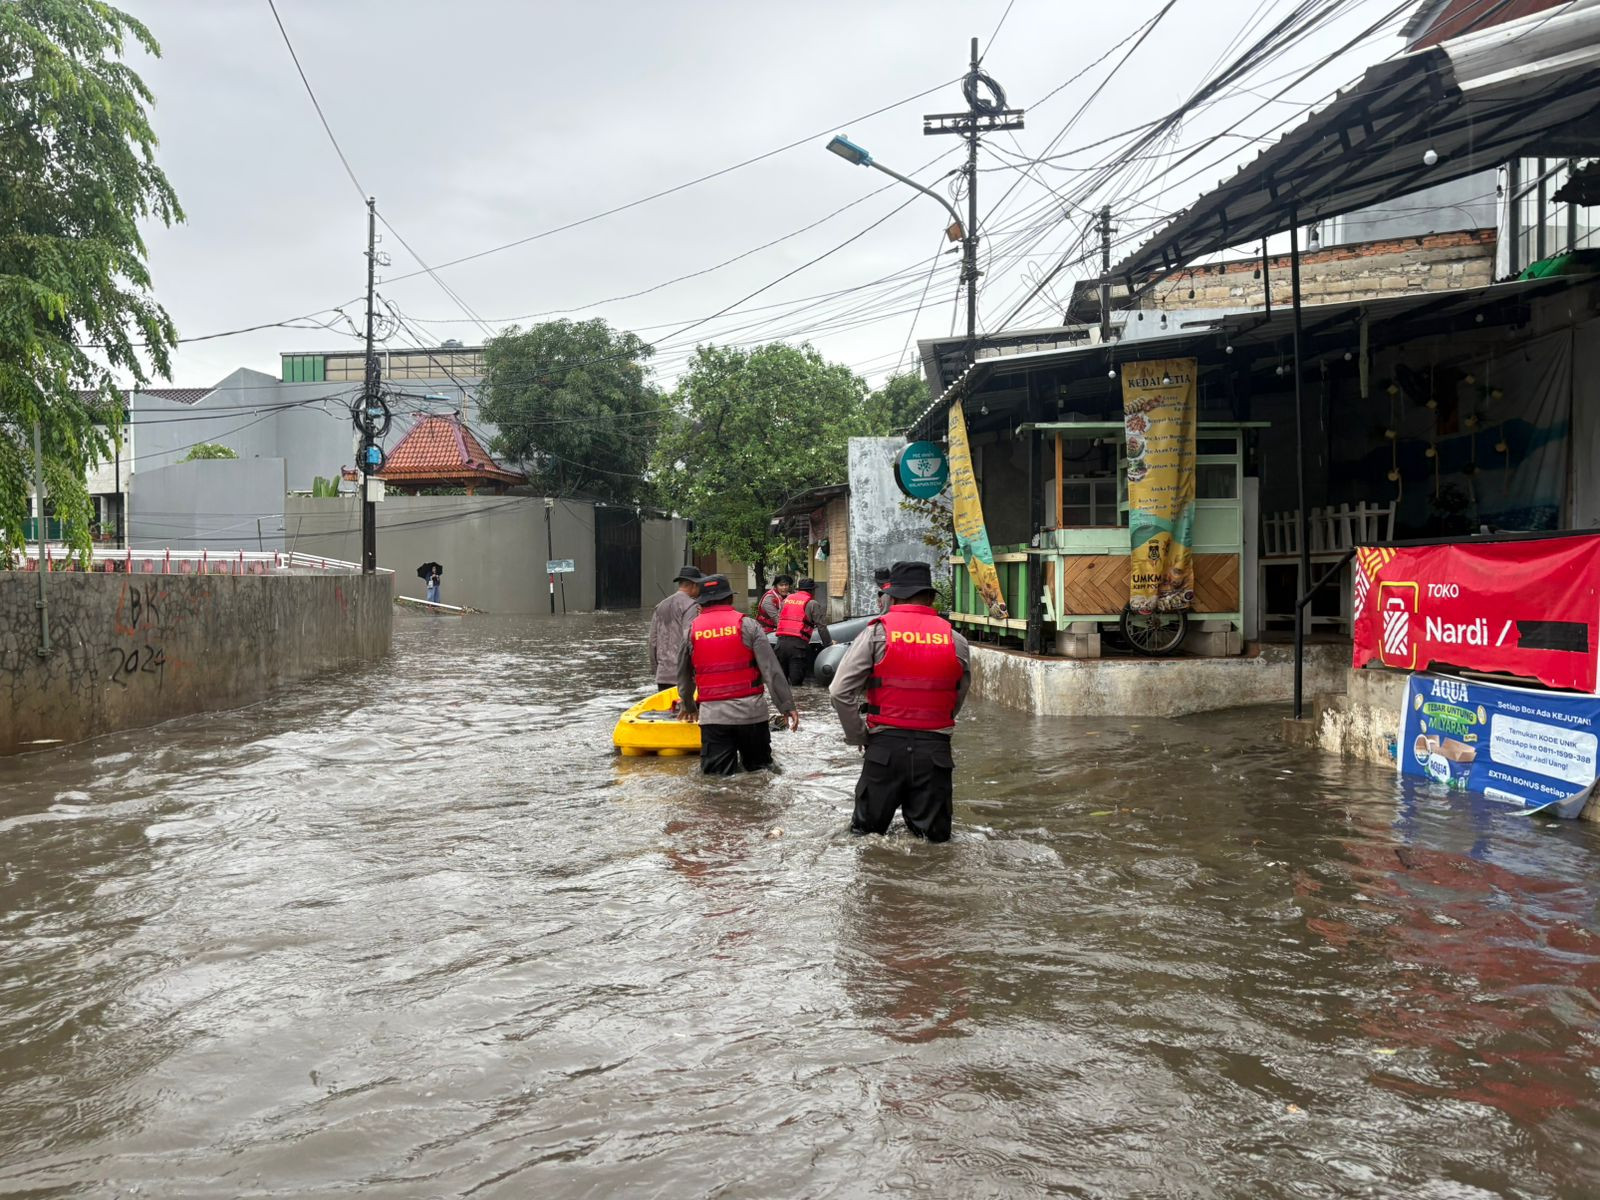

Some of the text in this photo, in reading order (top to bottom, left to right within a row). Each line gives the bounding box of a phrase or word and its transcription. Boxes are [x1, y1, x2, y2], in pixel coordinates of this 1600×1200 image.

[1128, 374, 1191, 388] KEDAI ETIA
[1132, 574, 1162, 583] UMKM
[1427, 583, 1459, 598] TOKO
[784, 598, 805, 606] POLISI
[695, 626, 737, 640] POLISI
[891, 631, 949, 645] POLISI
[1425, 615, 1488, 646] Nardi
[1431, 678, 1469, 703] AQUA
[1427, 703, 1446, 712] TEBAR
[1447, 706, 1474, 722] UNTUNG
[1497, 701, 1592, 726] Setiap Box Ada KEJUTAN!
[1428, 717, 1469, 736] MILYARAN
[1495, 735, 1528, 749] WhatsApp
[1529, 743, 1537, 751] ke
[1509, 727, 1577, 748] Temukan KODE UNIK
[1514, 750, 1568, 771] Tukar Jadi Uang!
[1488, 769, 1512, 782] EXTRA
[1513, 776, 1540, 790] BONUS
[1540, 784, 1565, 798] Setiap
